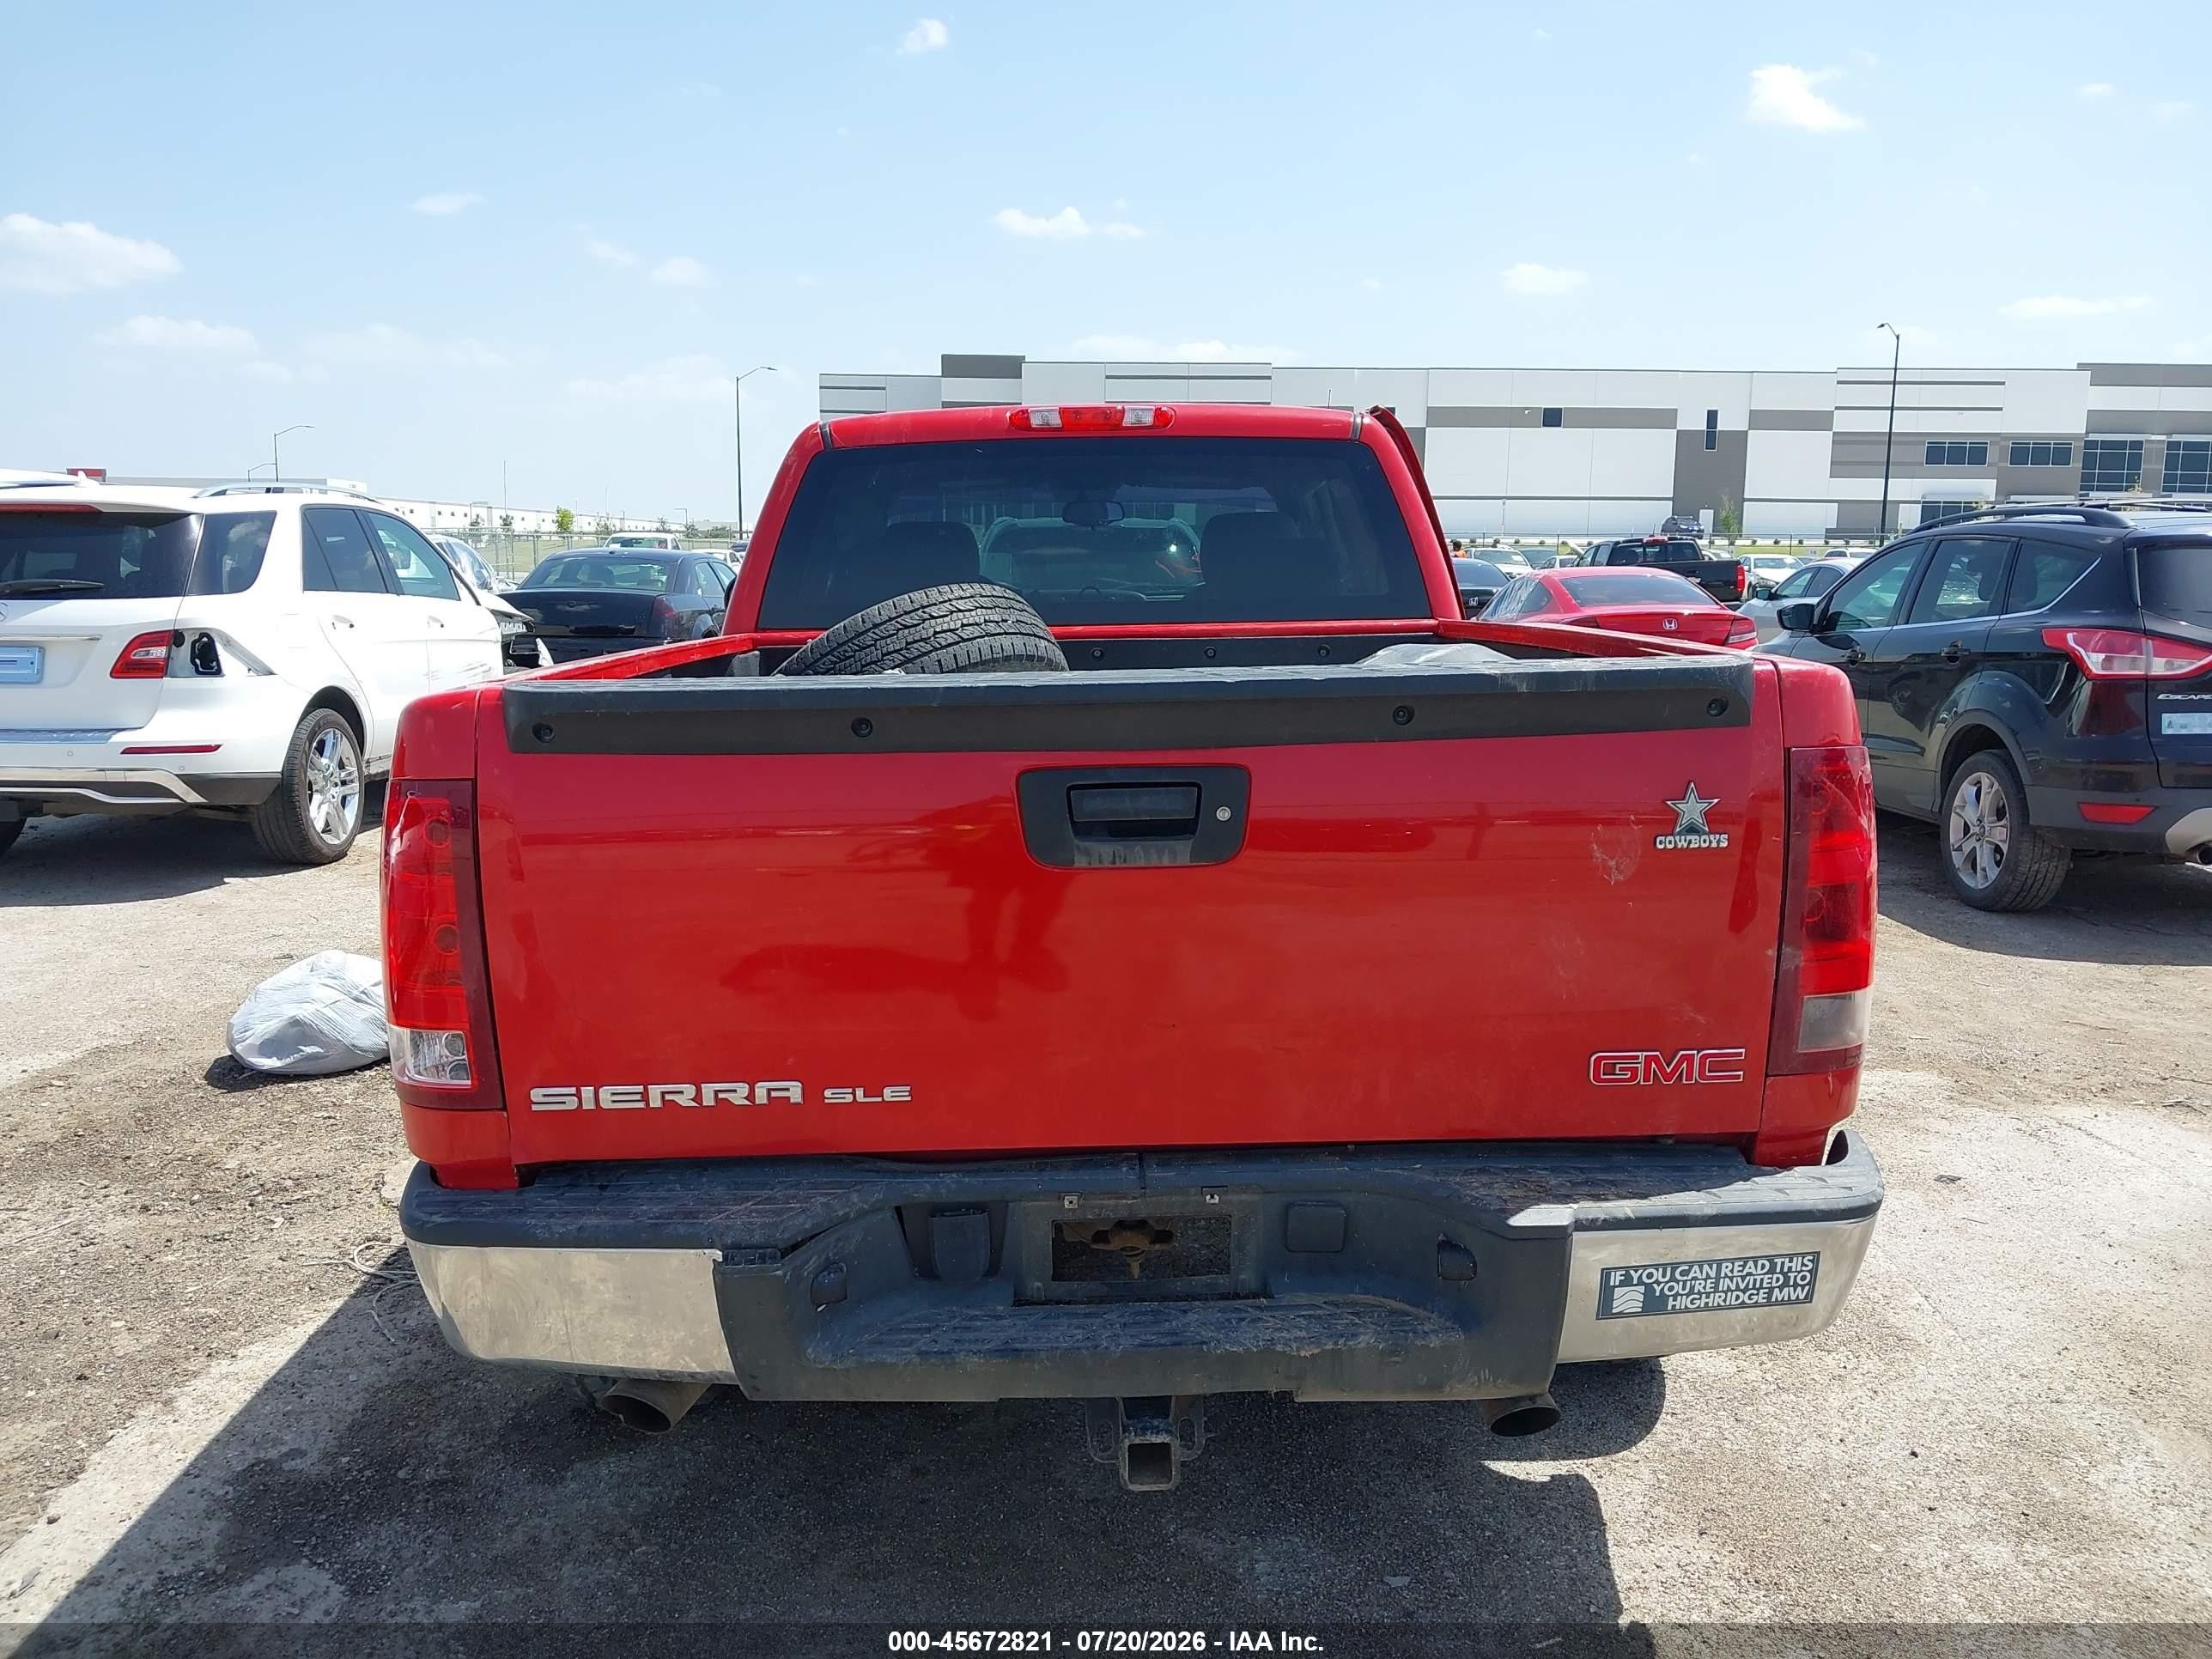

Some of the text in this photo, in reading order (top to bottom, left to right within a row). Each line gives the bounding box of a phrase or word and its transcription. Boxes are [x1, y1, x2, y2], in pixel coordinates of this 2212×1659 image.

[1655, 834, 1729, 849] COWBOYS
[1589, 1048, 1746, 1085] GMC
[529, 1081, 912, 1111] SIERRA SLE
[1609, 1255, 1814, 1286] IF YOU CAN READ THIS
[1651, 1272, 1811, 1297] YOU'RE INVITED TO
[1667, 1285, 1810, 1311] HIGHRIDGE MW
